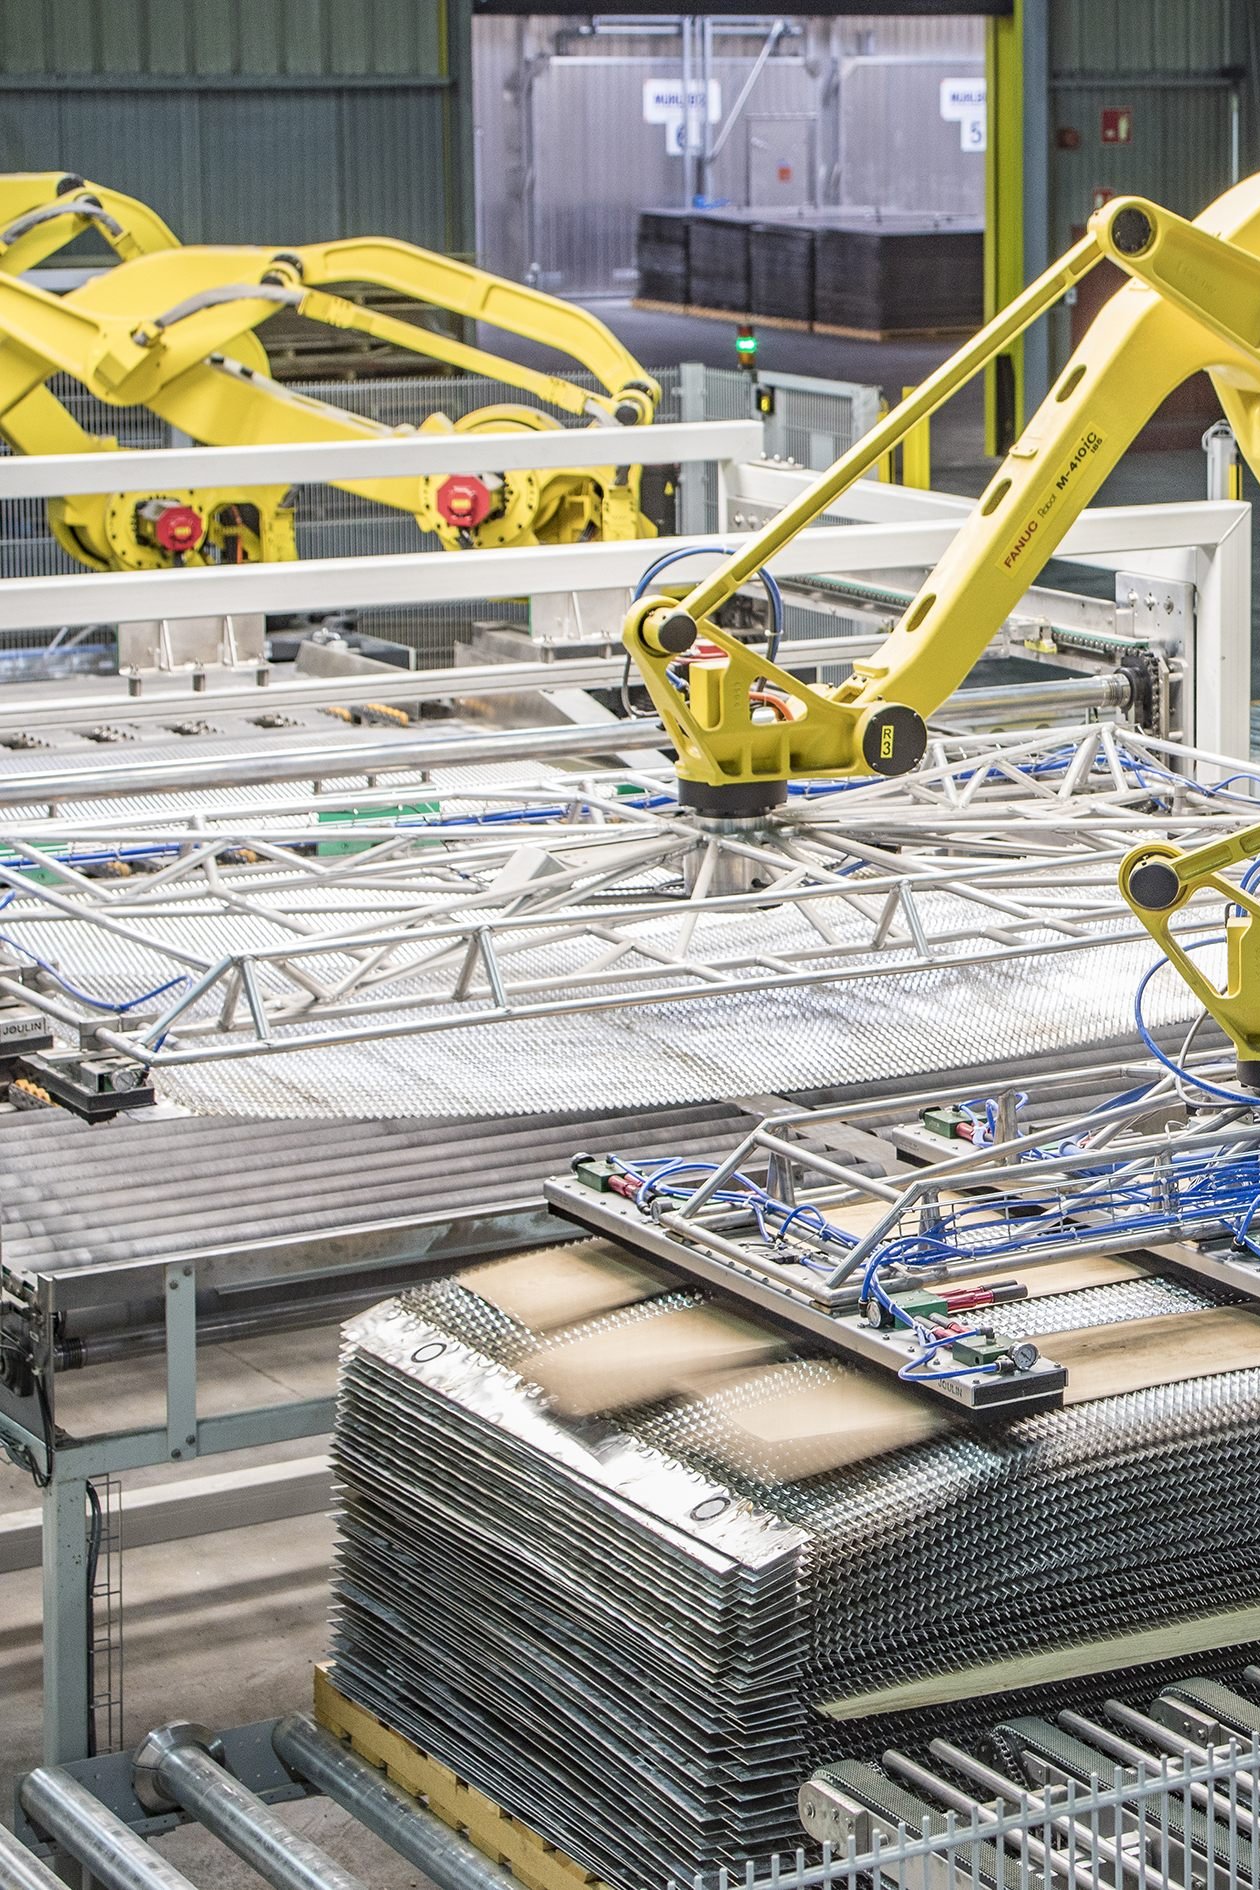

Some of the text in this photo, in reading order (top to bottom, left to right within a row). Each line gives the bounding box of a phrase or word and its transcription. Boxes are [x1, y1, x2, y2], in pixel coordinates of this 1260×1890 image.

[971, 121, 982, 143] 5
[1003, 520, 1038, 569] FANUC
[1037, 493, 1057, 519] Robot
[883, 728, 892, 739] R
[882, 741, 891, 756] 3
[3, 1021, 42, 1036] JOULIN
